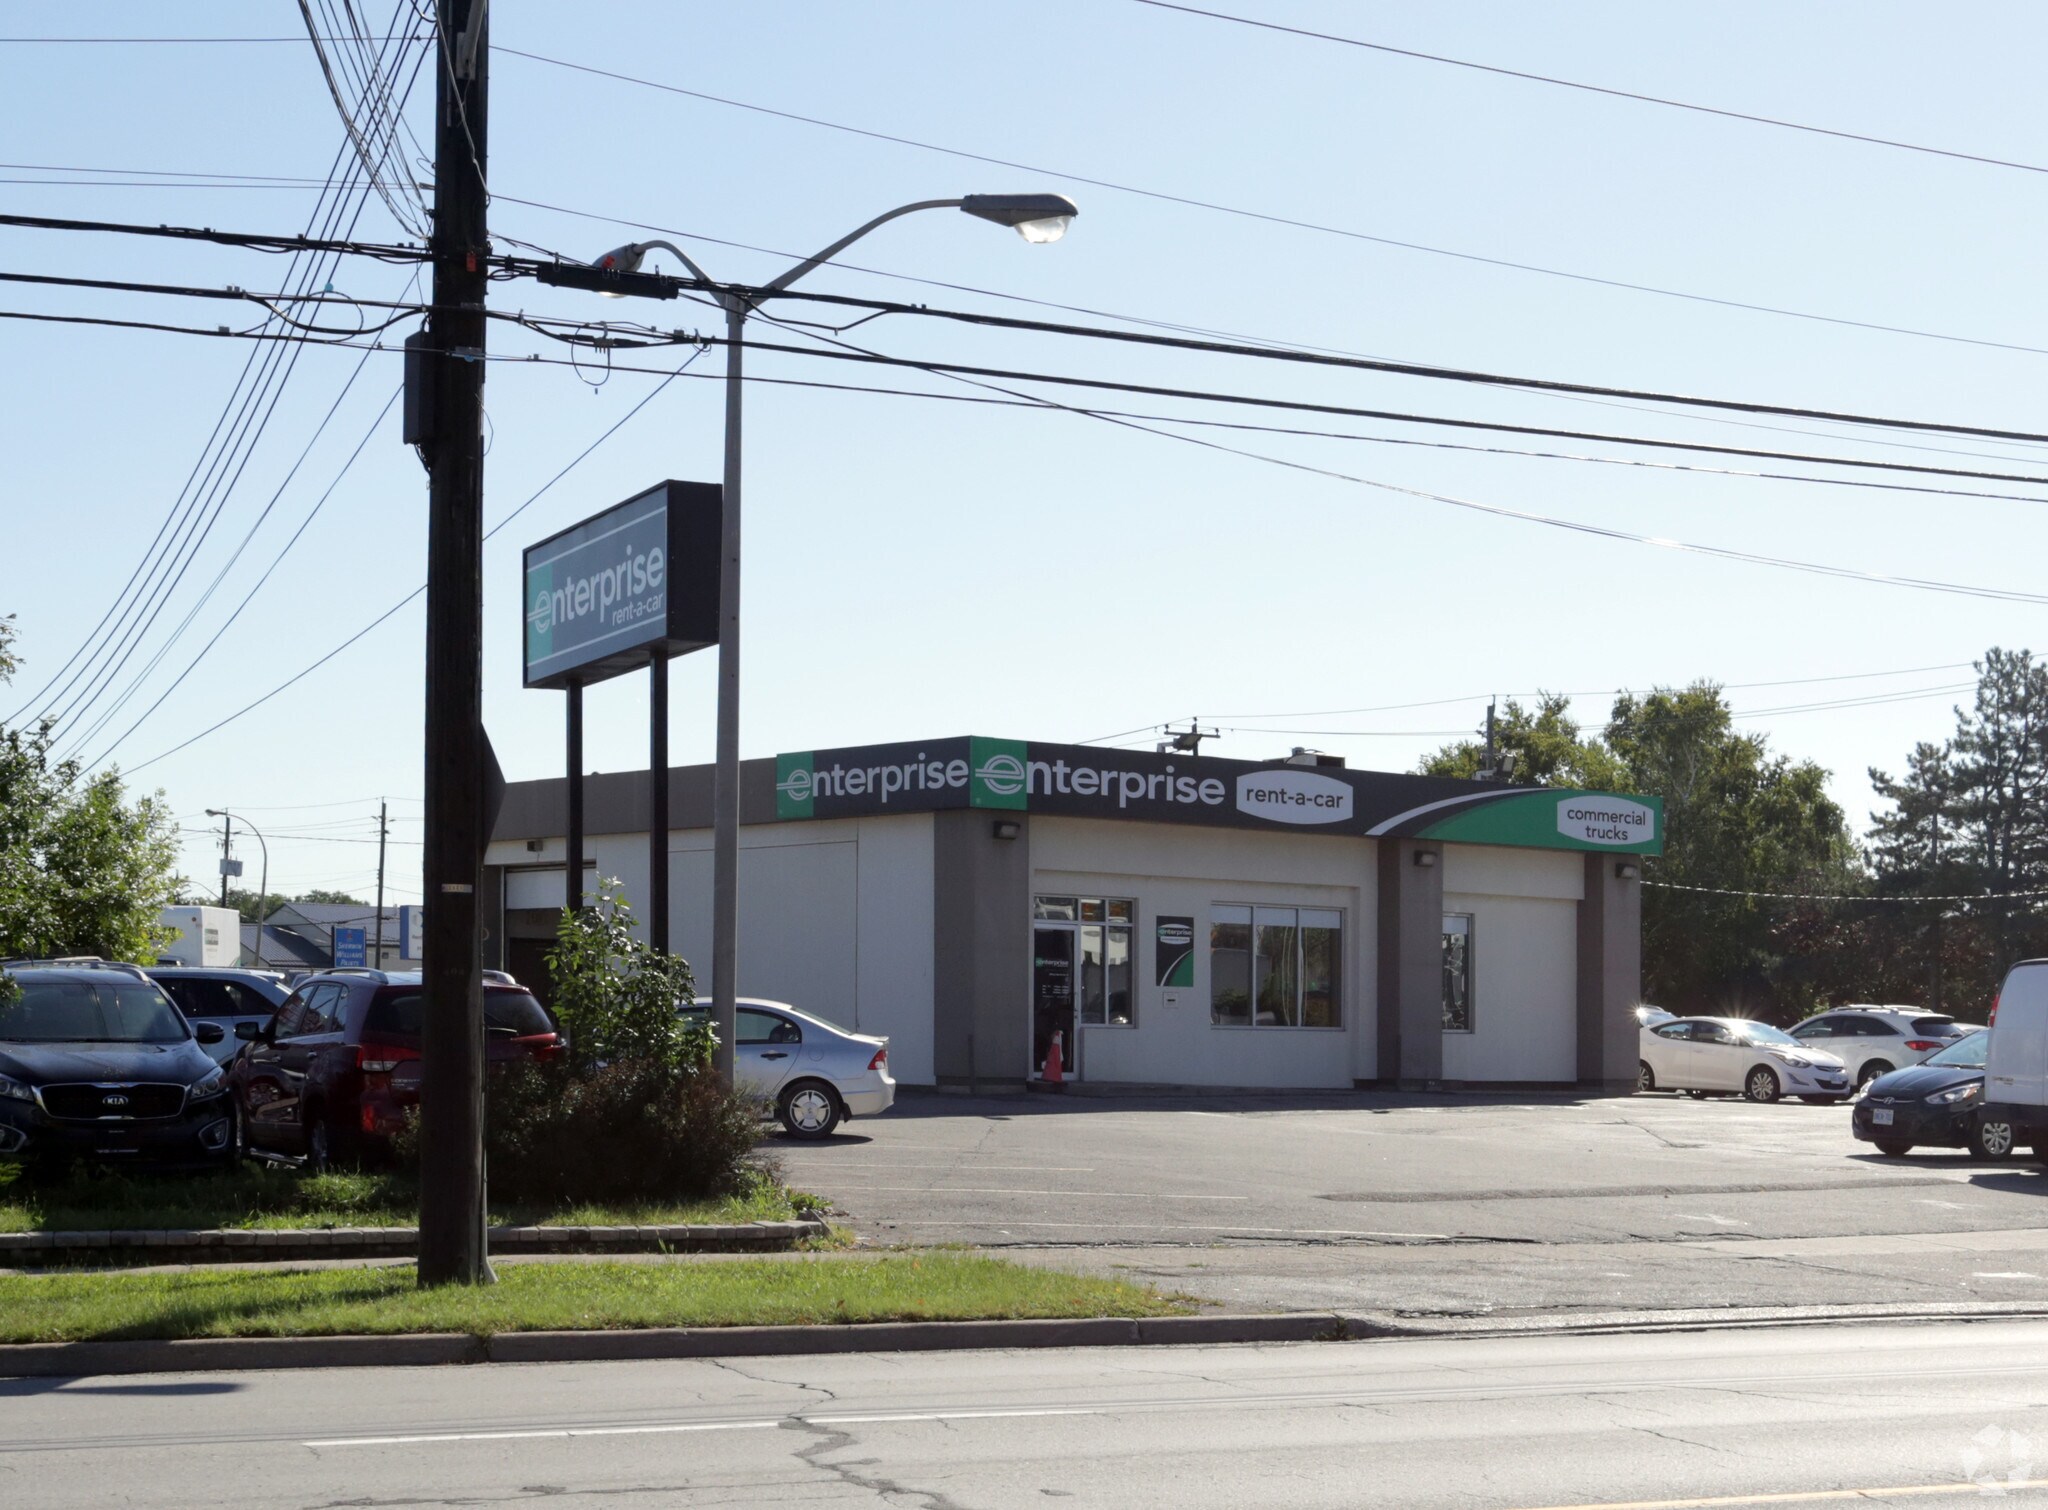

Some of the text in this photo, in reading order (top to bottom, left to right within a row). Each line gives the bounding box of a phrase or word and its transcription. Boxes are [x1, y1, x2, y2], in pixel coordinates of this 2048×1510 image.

[528, 544, 664, 634] enterprise
[612, 592, 664, 626] rent-a-car
[777, 752, 969, 803] enterprise
[975, 754, 1226, 808] enterprise
[1246, 785, 1344, 809] rent-a-car
[1567, 806, 1646, 826] commercial
[1586, 825, 1628, 841] trucks
